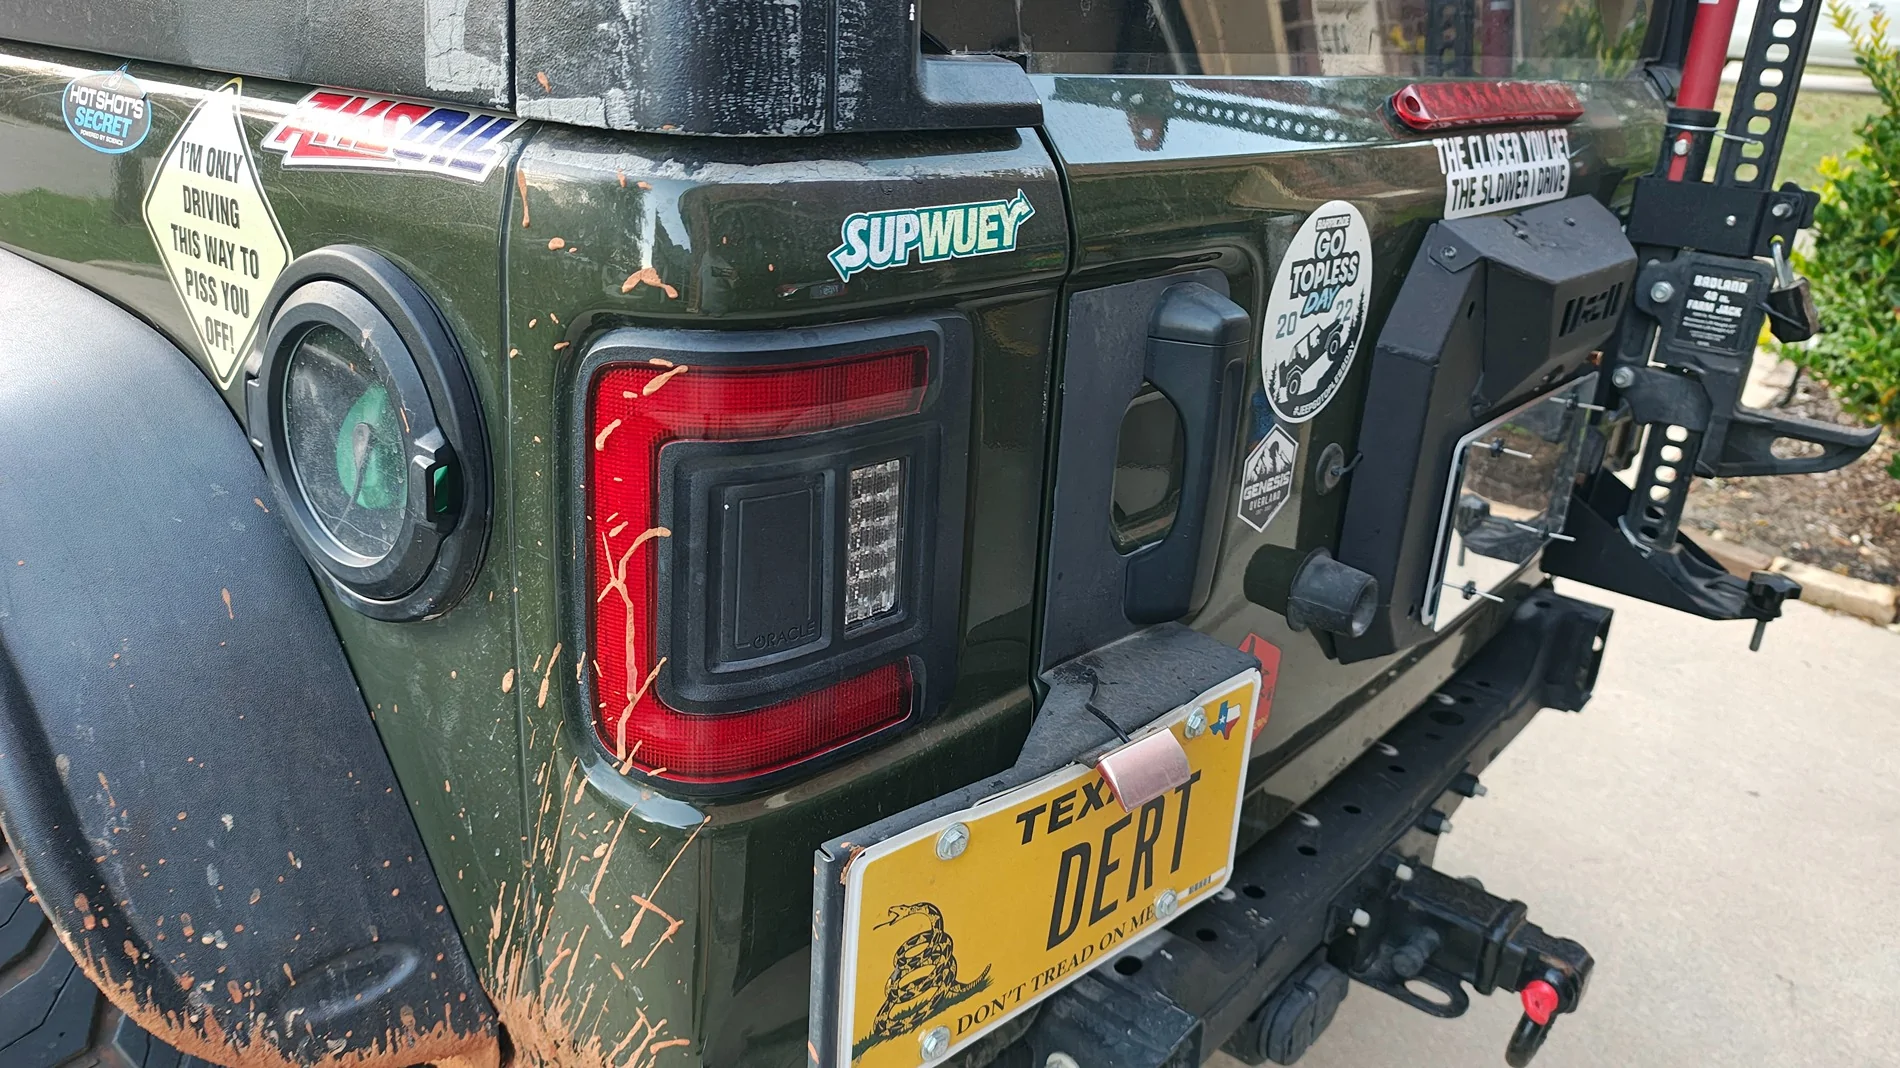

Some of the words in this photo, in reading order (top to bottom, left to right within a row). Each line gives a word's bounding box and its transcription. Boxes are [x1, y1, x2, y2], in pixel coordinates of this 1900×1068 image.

[75, 106, 132, 138] SECRET
[80, 129, 100, 140] POWERED
[274, 91, 518, 174] AMSOIL
[180, 141, 203, 173] I'M
[206, 147, 243, 184] ONLY
[1432, 136, 1467, 174] THE
[1468, 132, 1522, 169] CLOSER
[1521, 130, 1549, 163] YOU
[1548, 128, 1570, 160] GET
[182, 184, 240, 230] DRIVING
[1452, 176, 1477, 211] THE
[1479, 169, 1529, 206] SLOWER
[1530, 168, 1536, 198] I
[1537, 164, 1565, 196] DRIVE
[171, 222, 201, 260] THIS
[203, 233, 235, 271] WAY
[240, 246, 260, 280] TO
[832, 202, 1033, 271] SUPWUEY
[1316, 229, 1345, 259] GO
[185, 267, 218, 307] PISS
[221, 280, 250, 319] YOU
[1292, 255, 1359, 294] TOPLESS
[1693, 274, 1749, 294] BADLAND
[1275, 311, 1298, 340] 20
[1335, 298, 1354, 324] 22
[1302, 284, 1341, 317] DAY
[1686, 299, 1716, 313] FARM
[1715, 304, 1743, 318] JACK
[204, 315, 236, 355] OFF!
[1243, 470, 1291, 501] GENESIS
[1248, 490, 1281, 511] OVERLAND
[753, 620, 816, 651] ORACLE
[1015, 776, 1115, 846] TEX
[1045, 768, 1202, 952] DERT
[955, 983, 1027, 1036] DON'T
[1031, 944, 1095, 992] TREAD
[1099, 922, 1127, 951] ON
[1129, 902, 1155, 933] ME
